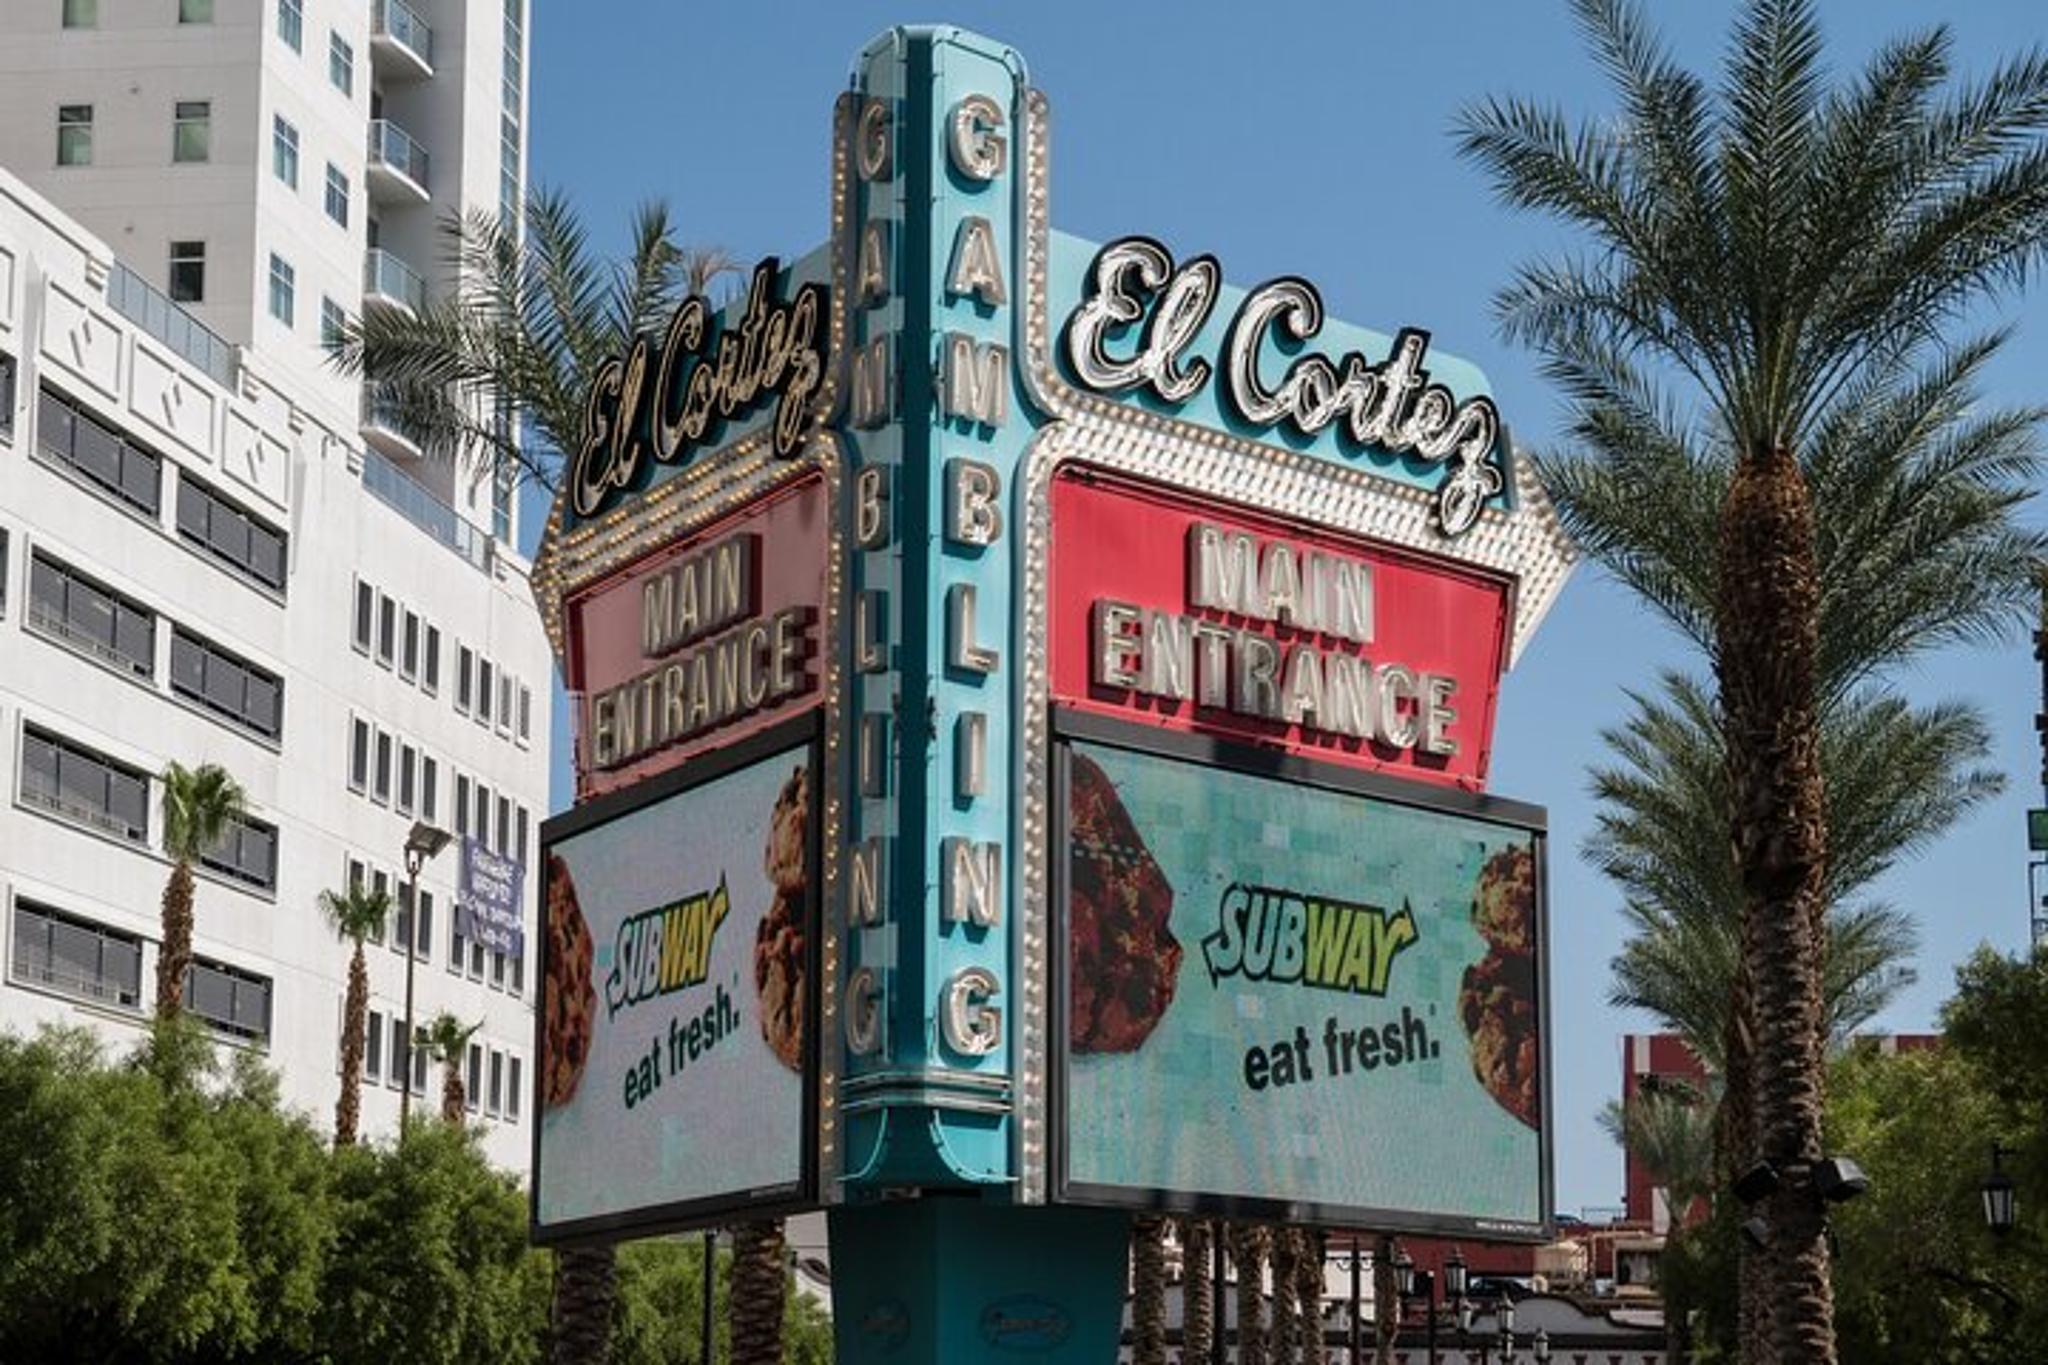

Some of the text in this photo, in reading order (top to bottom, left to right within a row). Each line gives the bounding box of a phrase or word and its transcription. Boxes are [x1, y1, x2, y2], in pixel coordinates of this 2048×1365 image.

[573, 257, 826, 517] El Cortez
[1057, 236, 1503, 536] El Cortez
[643, 534, 752, 658] MAIN
[846, 95, 893, 1055] GAMBLING
[940, 93, 1007, 1056] GAMBLING
[1187, 521, 1375, 644] MAIN
[592, 606, 803, 768] ENTRANCE
[1091, 598, 1459, 757] ENTRANCE
[605, 870, 730, 1023] SUBWAY
[1201, 881, 1419, 998] SUBWAY
[624, 984, 740, 1109] eat fresh.
[1244, 1006, 1440, 1091] eat fresh.
